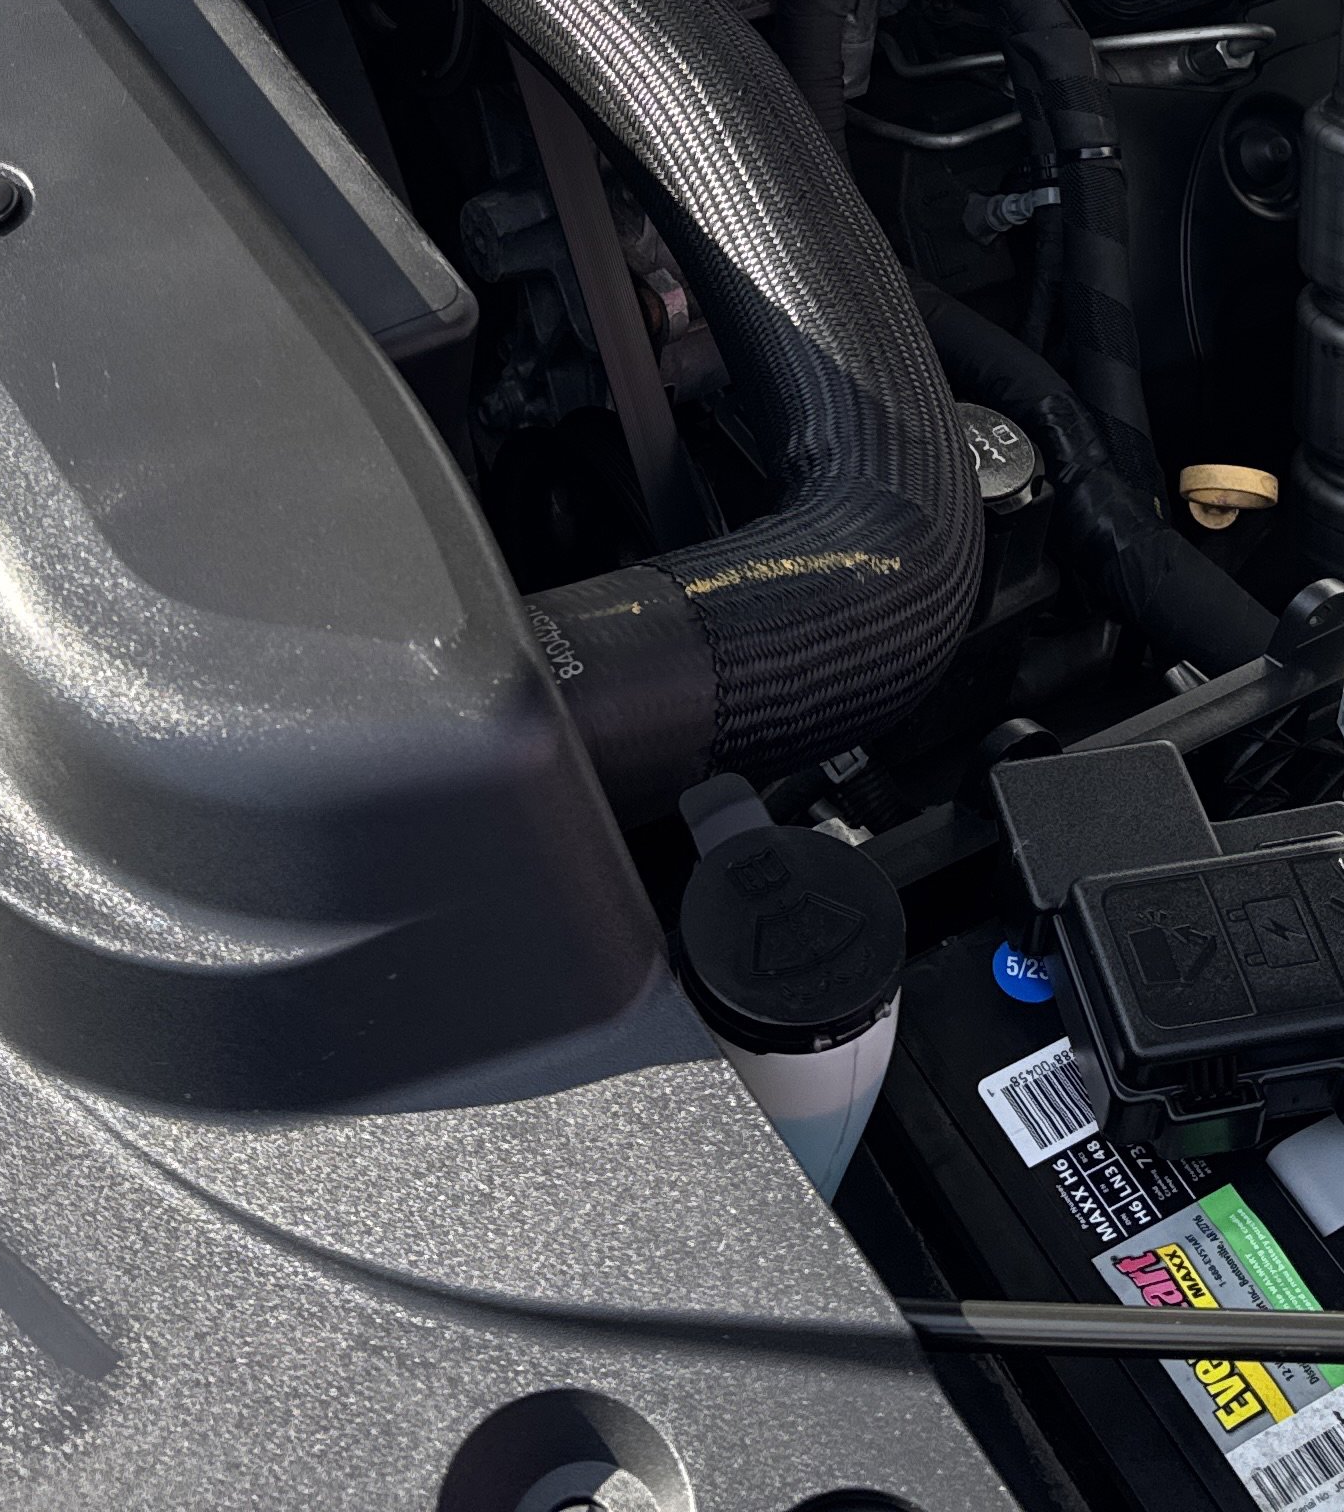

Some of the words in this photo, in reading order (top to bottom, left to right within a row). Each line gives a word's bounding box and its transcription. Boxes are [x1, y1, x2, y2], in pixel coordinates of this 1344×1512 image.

[1087, 1141, 1105, 1159] 48
[1053, 1159, 1078, 1185] H6
[1105, 1166, 1131, 1197] LN3
[1151, 1169, 1171, 1197] Cranking
[1181, 1159, 1198, 1181] Crankin
[1152, 1186, 1165, 1200] Cold
[1164, 1176, 1178, 1193] Amps
[1056, 1185, 1078, 1213] Number
[1129, 1201, 1151, 1224] H6
[1071, 1186, 1116, 1241] MAXX
[1075, 1213, 1089, 1229] Part
[1206, 1231, 1219, 1242] AR
[1245, 1234, 1259, 1249] and
[1217, 1241, 1249, 1287] Bentonville,
[1262, 1241, 1285, 1271] battery
[1165, 1250, 1205, 1298] MAXX
[1245, 1254, 1277, 1294] WALMART
[1115, 1250, 1265, 1433] Eveart
